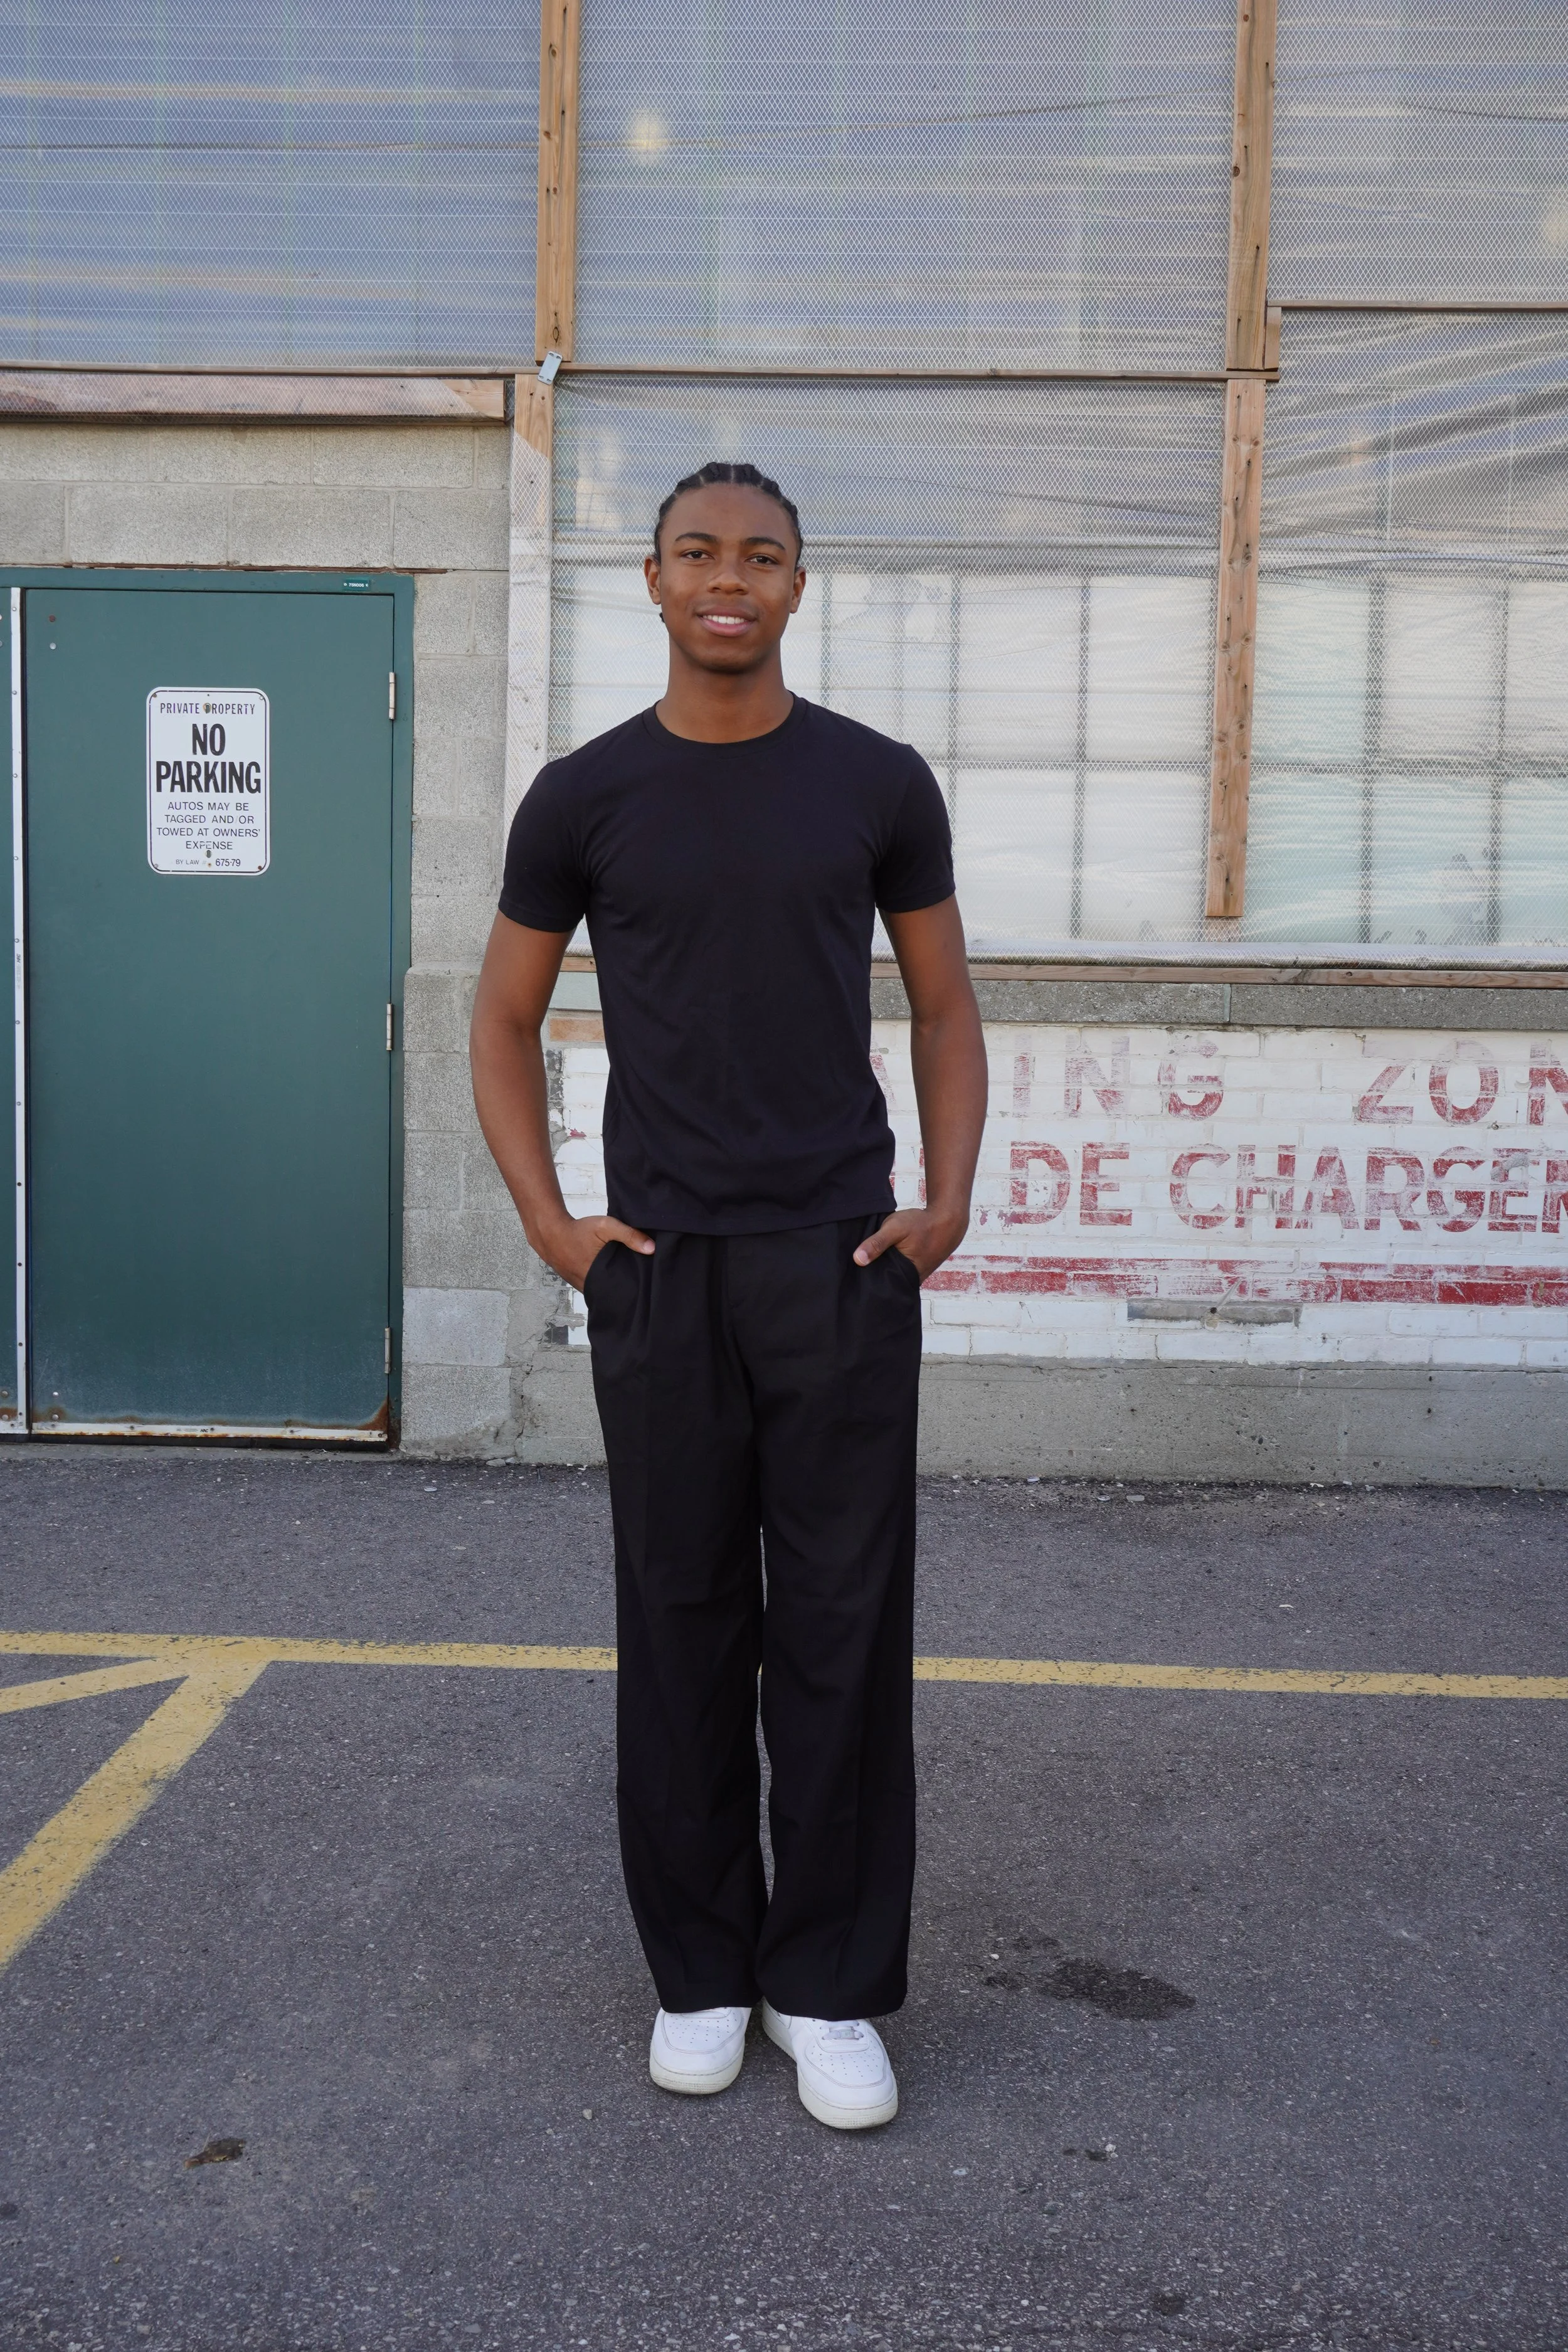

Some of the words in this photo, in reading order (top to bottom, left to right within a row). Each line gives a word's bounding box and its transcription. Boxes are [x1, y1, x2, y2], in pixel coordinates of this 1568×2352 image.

[160, 702, 200, 714] PRIVATE
[206, 703, 255, 714] ROPERTY
[192, 723, 226, 756] NO
[156, 761, 261, 794] PARKING
[167, 802, 203, 810] AUTOS
[208, 802, 230, 810] MAY
[235, 803, 249, 811] BE
[164, 815, 206, 823] TAGGED
[157, 827, 193, 836] TOWED
[197, 828, 209, 836] AT
[213, 829, 260, 837] OWNERS'
[186, 840, 233, 850] EXPENSE
[1009, 1140, 1133, 1226] DE
